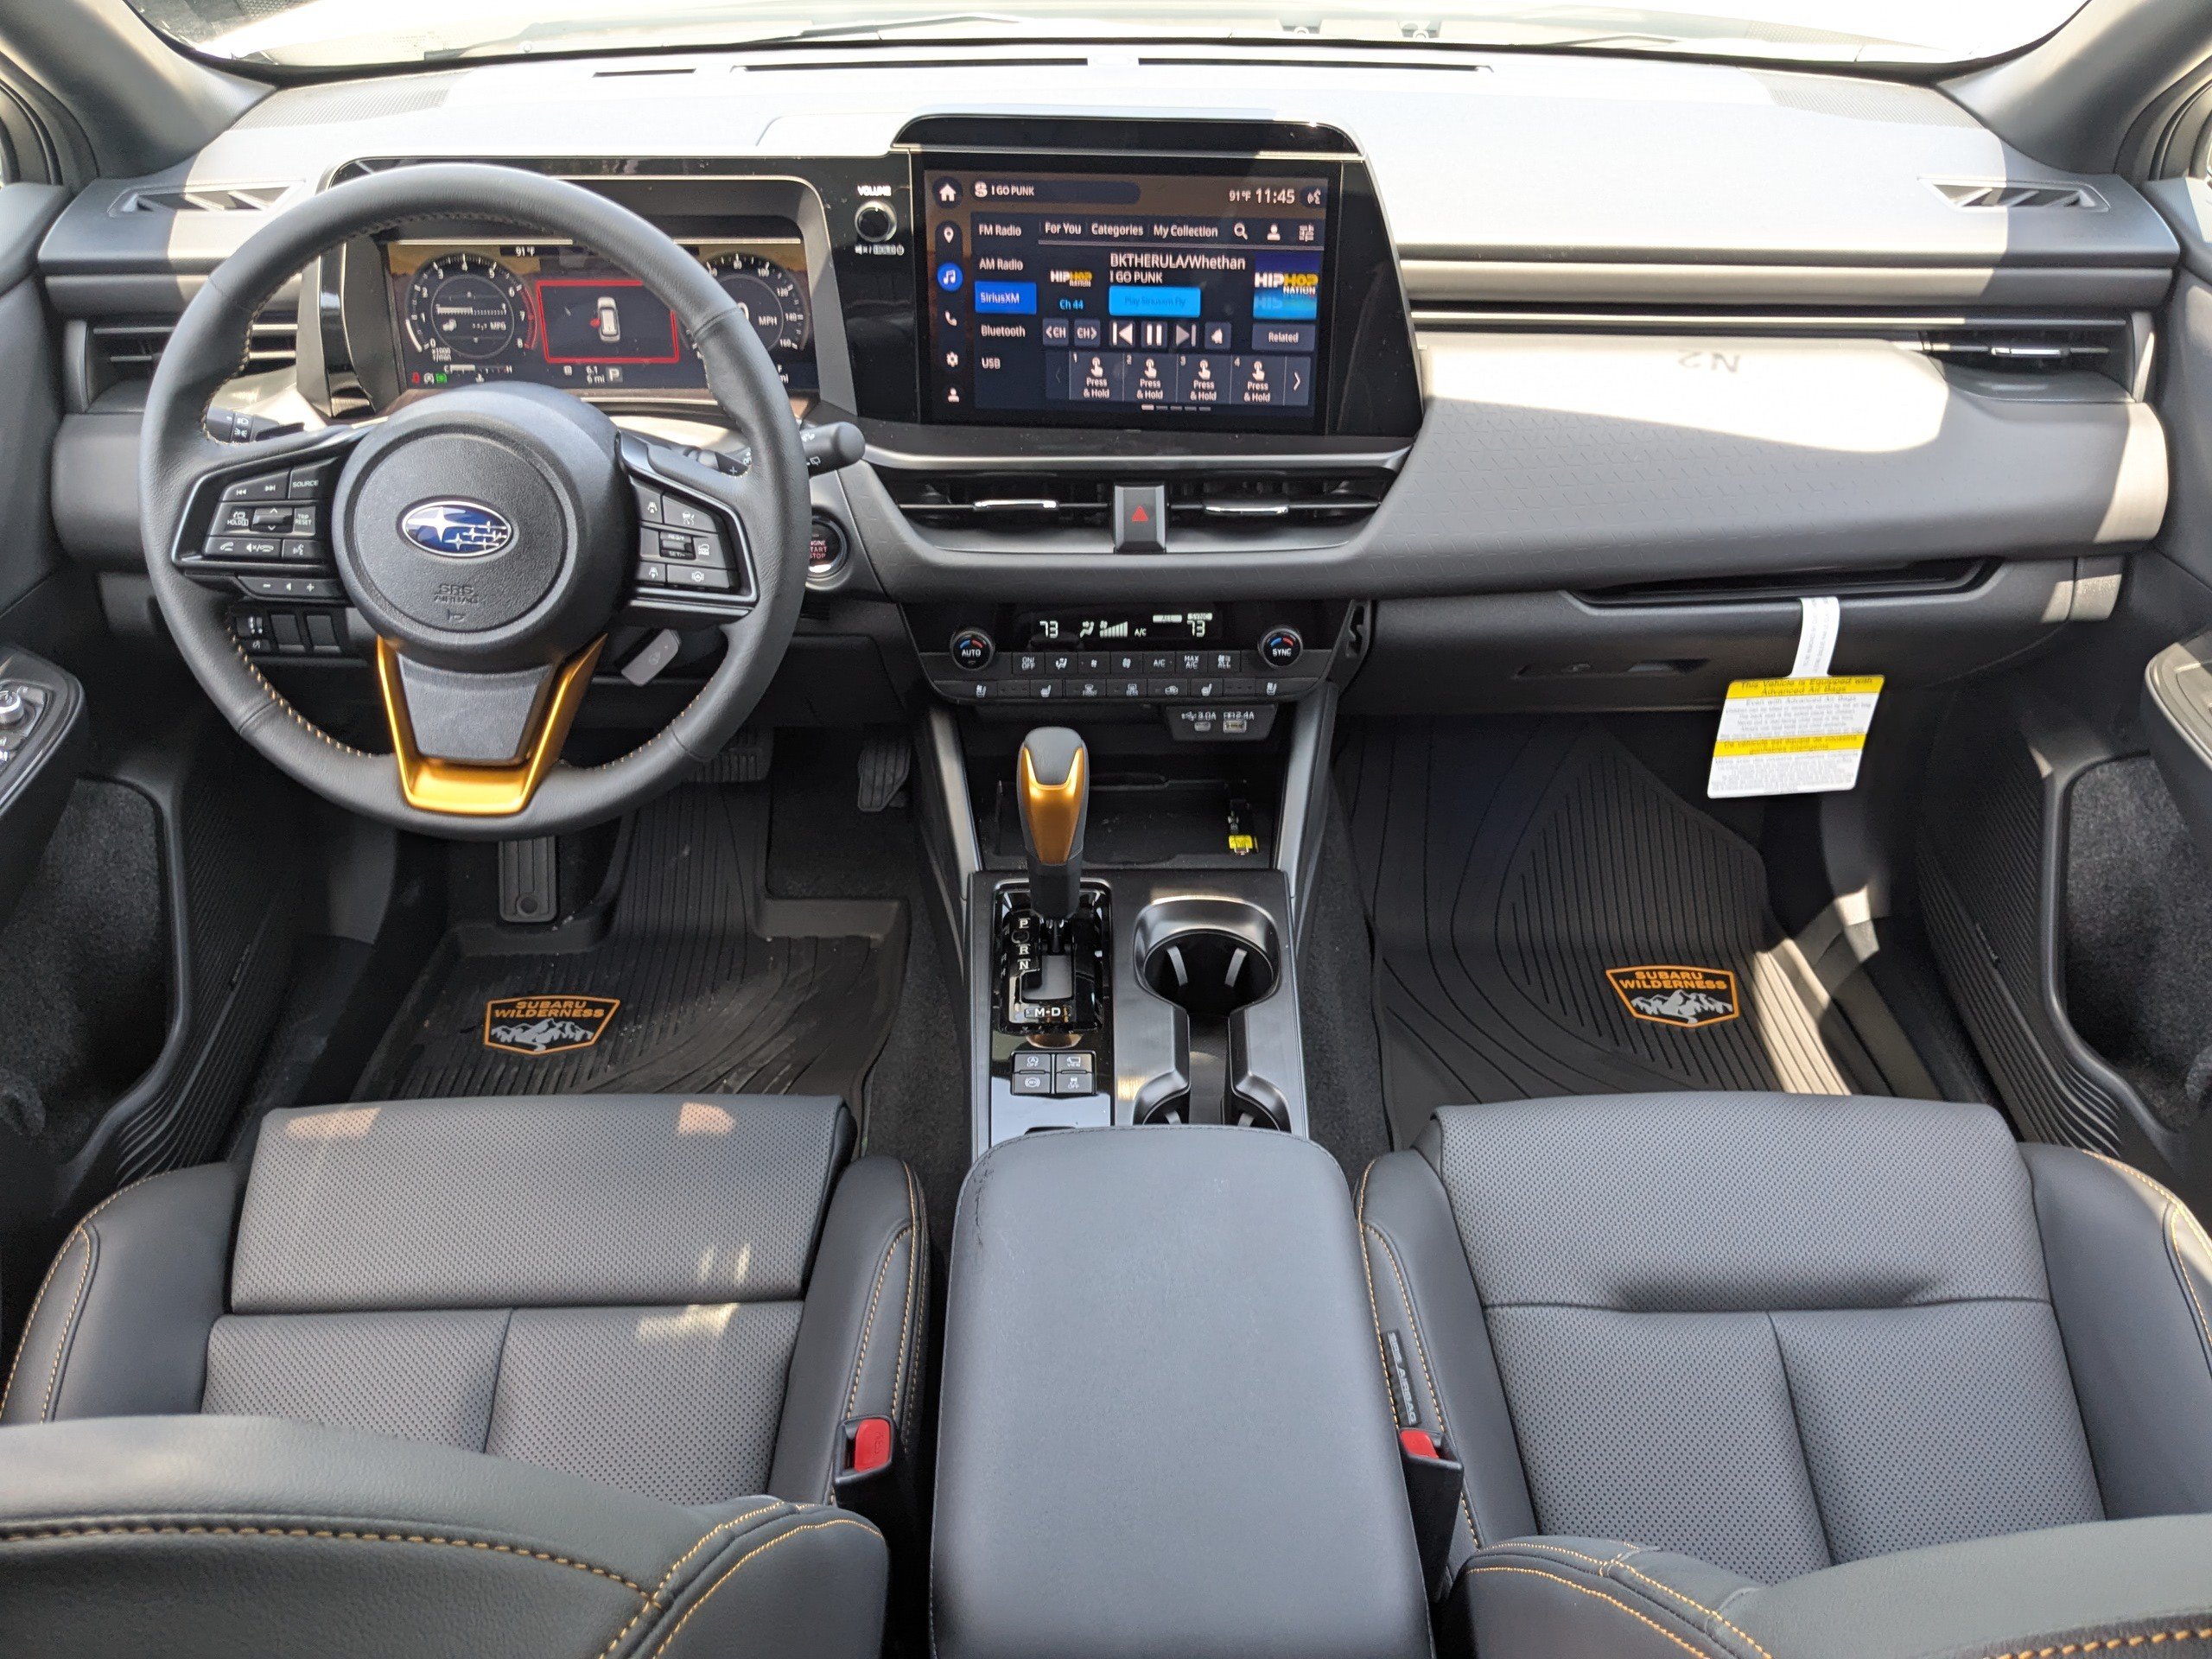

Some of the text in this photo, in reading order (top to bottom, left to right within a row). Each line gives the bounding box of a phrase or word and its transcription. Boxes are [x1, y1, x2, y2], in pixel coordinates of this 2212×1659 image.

[996, 185, 1010, 197] GO
[1011, 185, 1035, 197] PUNK
[1255, 188, 1295, 205] 11:45
[979, 224, 1022, 238] FM Radio
[1045, 221, 1082, 236] For You
[1091, 222, 1144, 238] Categories
[1154, 224, 1219, 239] My Collection
[979, 257, 1024, 272] AM Radio
[1109, 252, 1246, 270] BKTHERULA/Whethan
[1116, 271, 1132, 283] GO
[1134, 271, 1163, 284] PUNK
[1282, 286, 1316, 296] NATION
[980, 292, 1020, 304] SiriusXM
[1059, 299, 1084, 311] Ch 44
[758, 315, 778, 327] MPH
[981, 324, 1026, 338] Bluetooth
[1268, 331, 1299, 343] Related
[982, 357, 1001, 370] USB
[608, 367, 620, 382] P
[1085, 377, 1108, 388] Press
[1139, 378, 1161, 389] Press
[1193, 379, 1215, 391] Press
[1247, 380, 1268, 391] Press
[1083, 388, 1110, 399] & Hold
[1136, 389, 1164, 400] & Hold
[1190, 391, 1217, 402] & Hold
[1243, 391, 1271, 403] & Hold
[292, 480, 320, 488] SOURCE
[439, 582, 474, 595] SRS
[1039, 620, 1058, 639] 73
[1135, 628, 1147, 638] A/C
[1186, 620, 1205, 638] 73
[961, 649, 982, 658] AUTO
[1272, 648, 1292, 658] SYNC
[1154, 659, 1166, 668] A/C
[1020, 919, 1029, 928] P
[1020, 946, 1029, 955] R
[1020, 961, 1029, 969] N
[1634, 970, 1703, 982] SUBARU
[1618, 979, 1728, 990] WILDERNESS
[516, 1001, 588, 1010] SUBARU
[494, 1008, 605, 1019] WILDERNESS
[1398, 1367, 1417, 1425] AIRBAG
